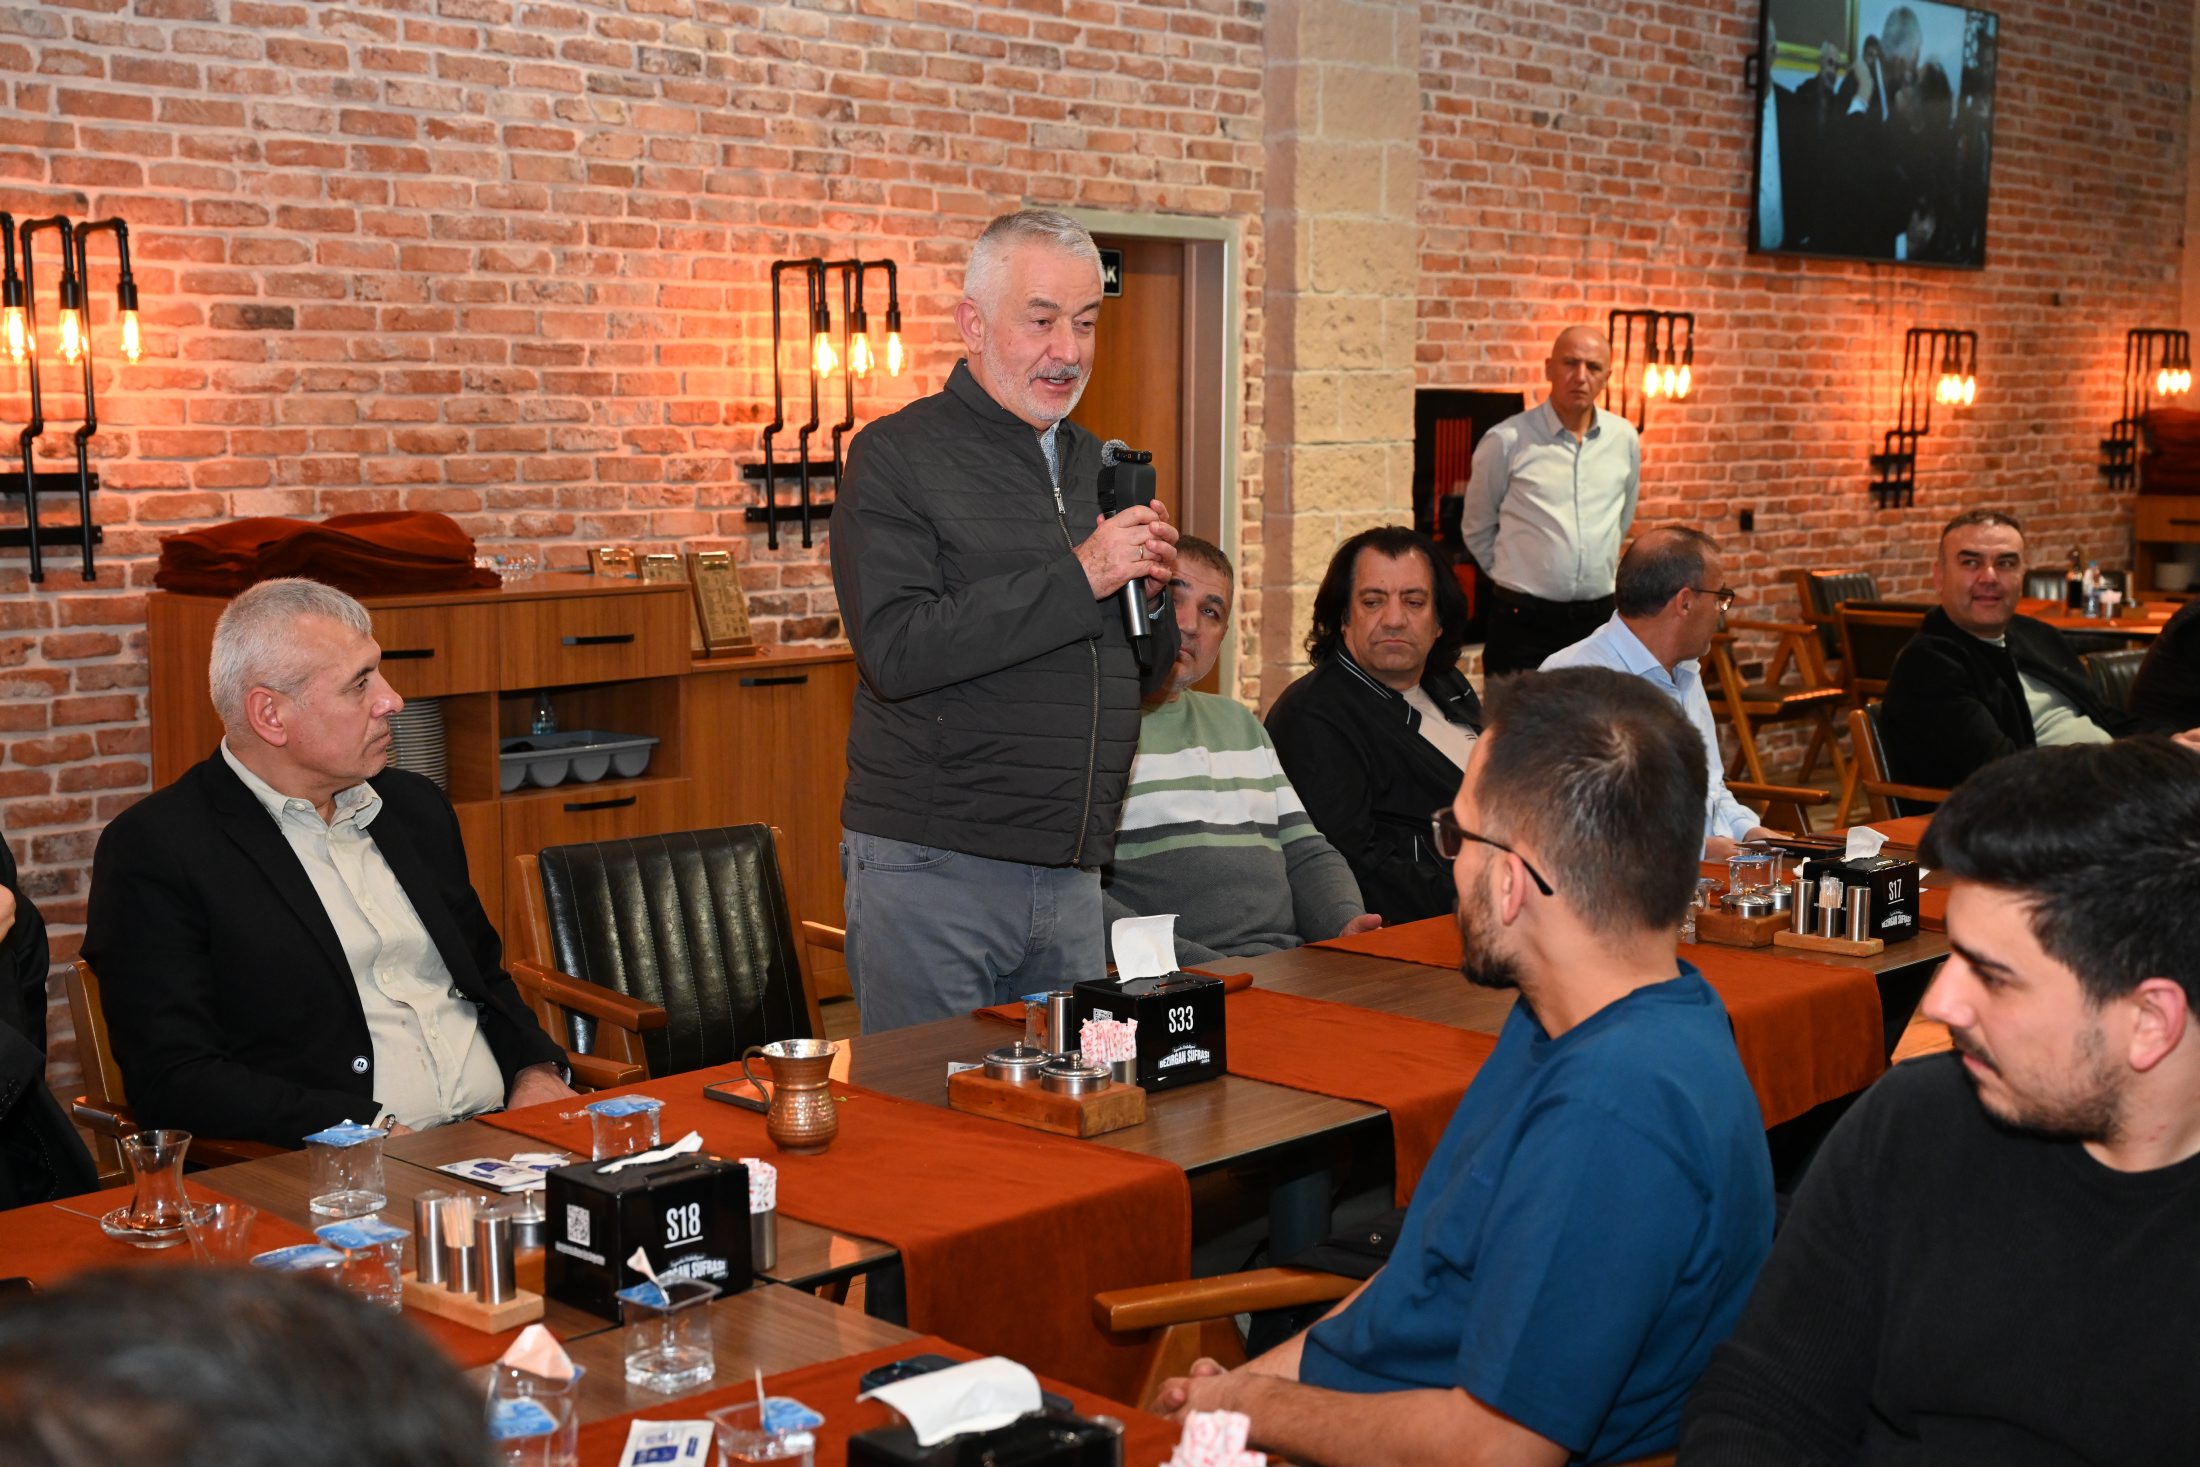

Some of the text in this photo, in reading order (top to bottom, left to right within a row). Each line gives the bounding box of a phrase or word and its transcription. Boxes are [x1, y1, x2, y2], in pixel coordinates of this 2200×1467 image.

[1888, 878, 1902, 901] S17
[1168, 1005, 1194, 1033] S33
[665, 1202, 701, 1242] S18
